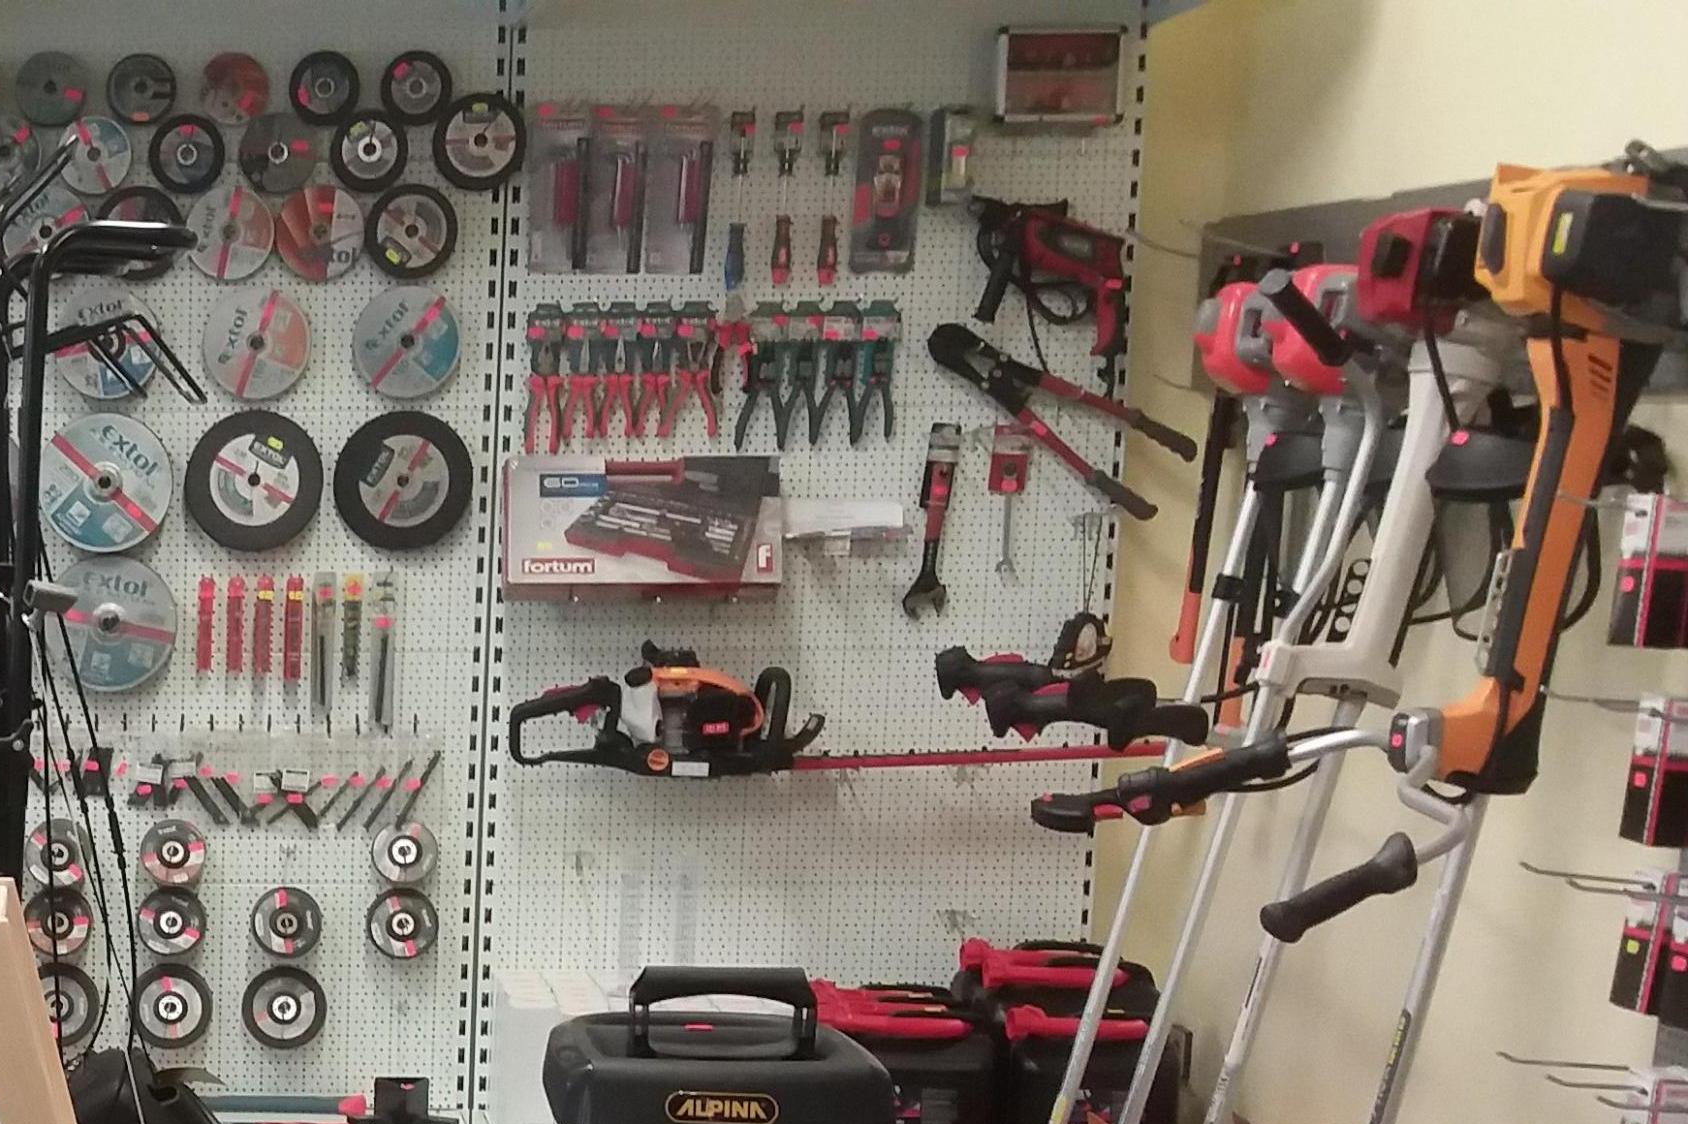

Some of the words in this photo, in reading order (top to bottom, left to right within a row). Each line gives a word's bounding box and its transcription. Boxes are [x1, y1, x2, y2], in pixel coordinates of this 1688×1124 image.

[101, 424, 159, 475] extol
[523, 558, 595, 574] fortum
[675, 1098, 767, 1120] ALPINA
